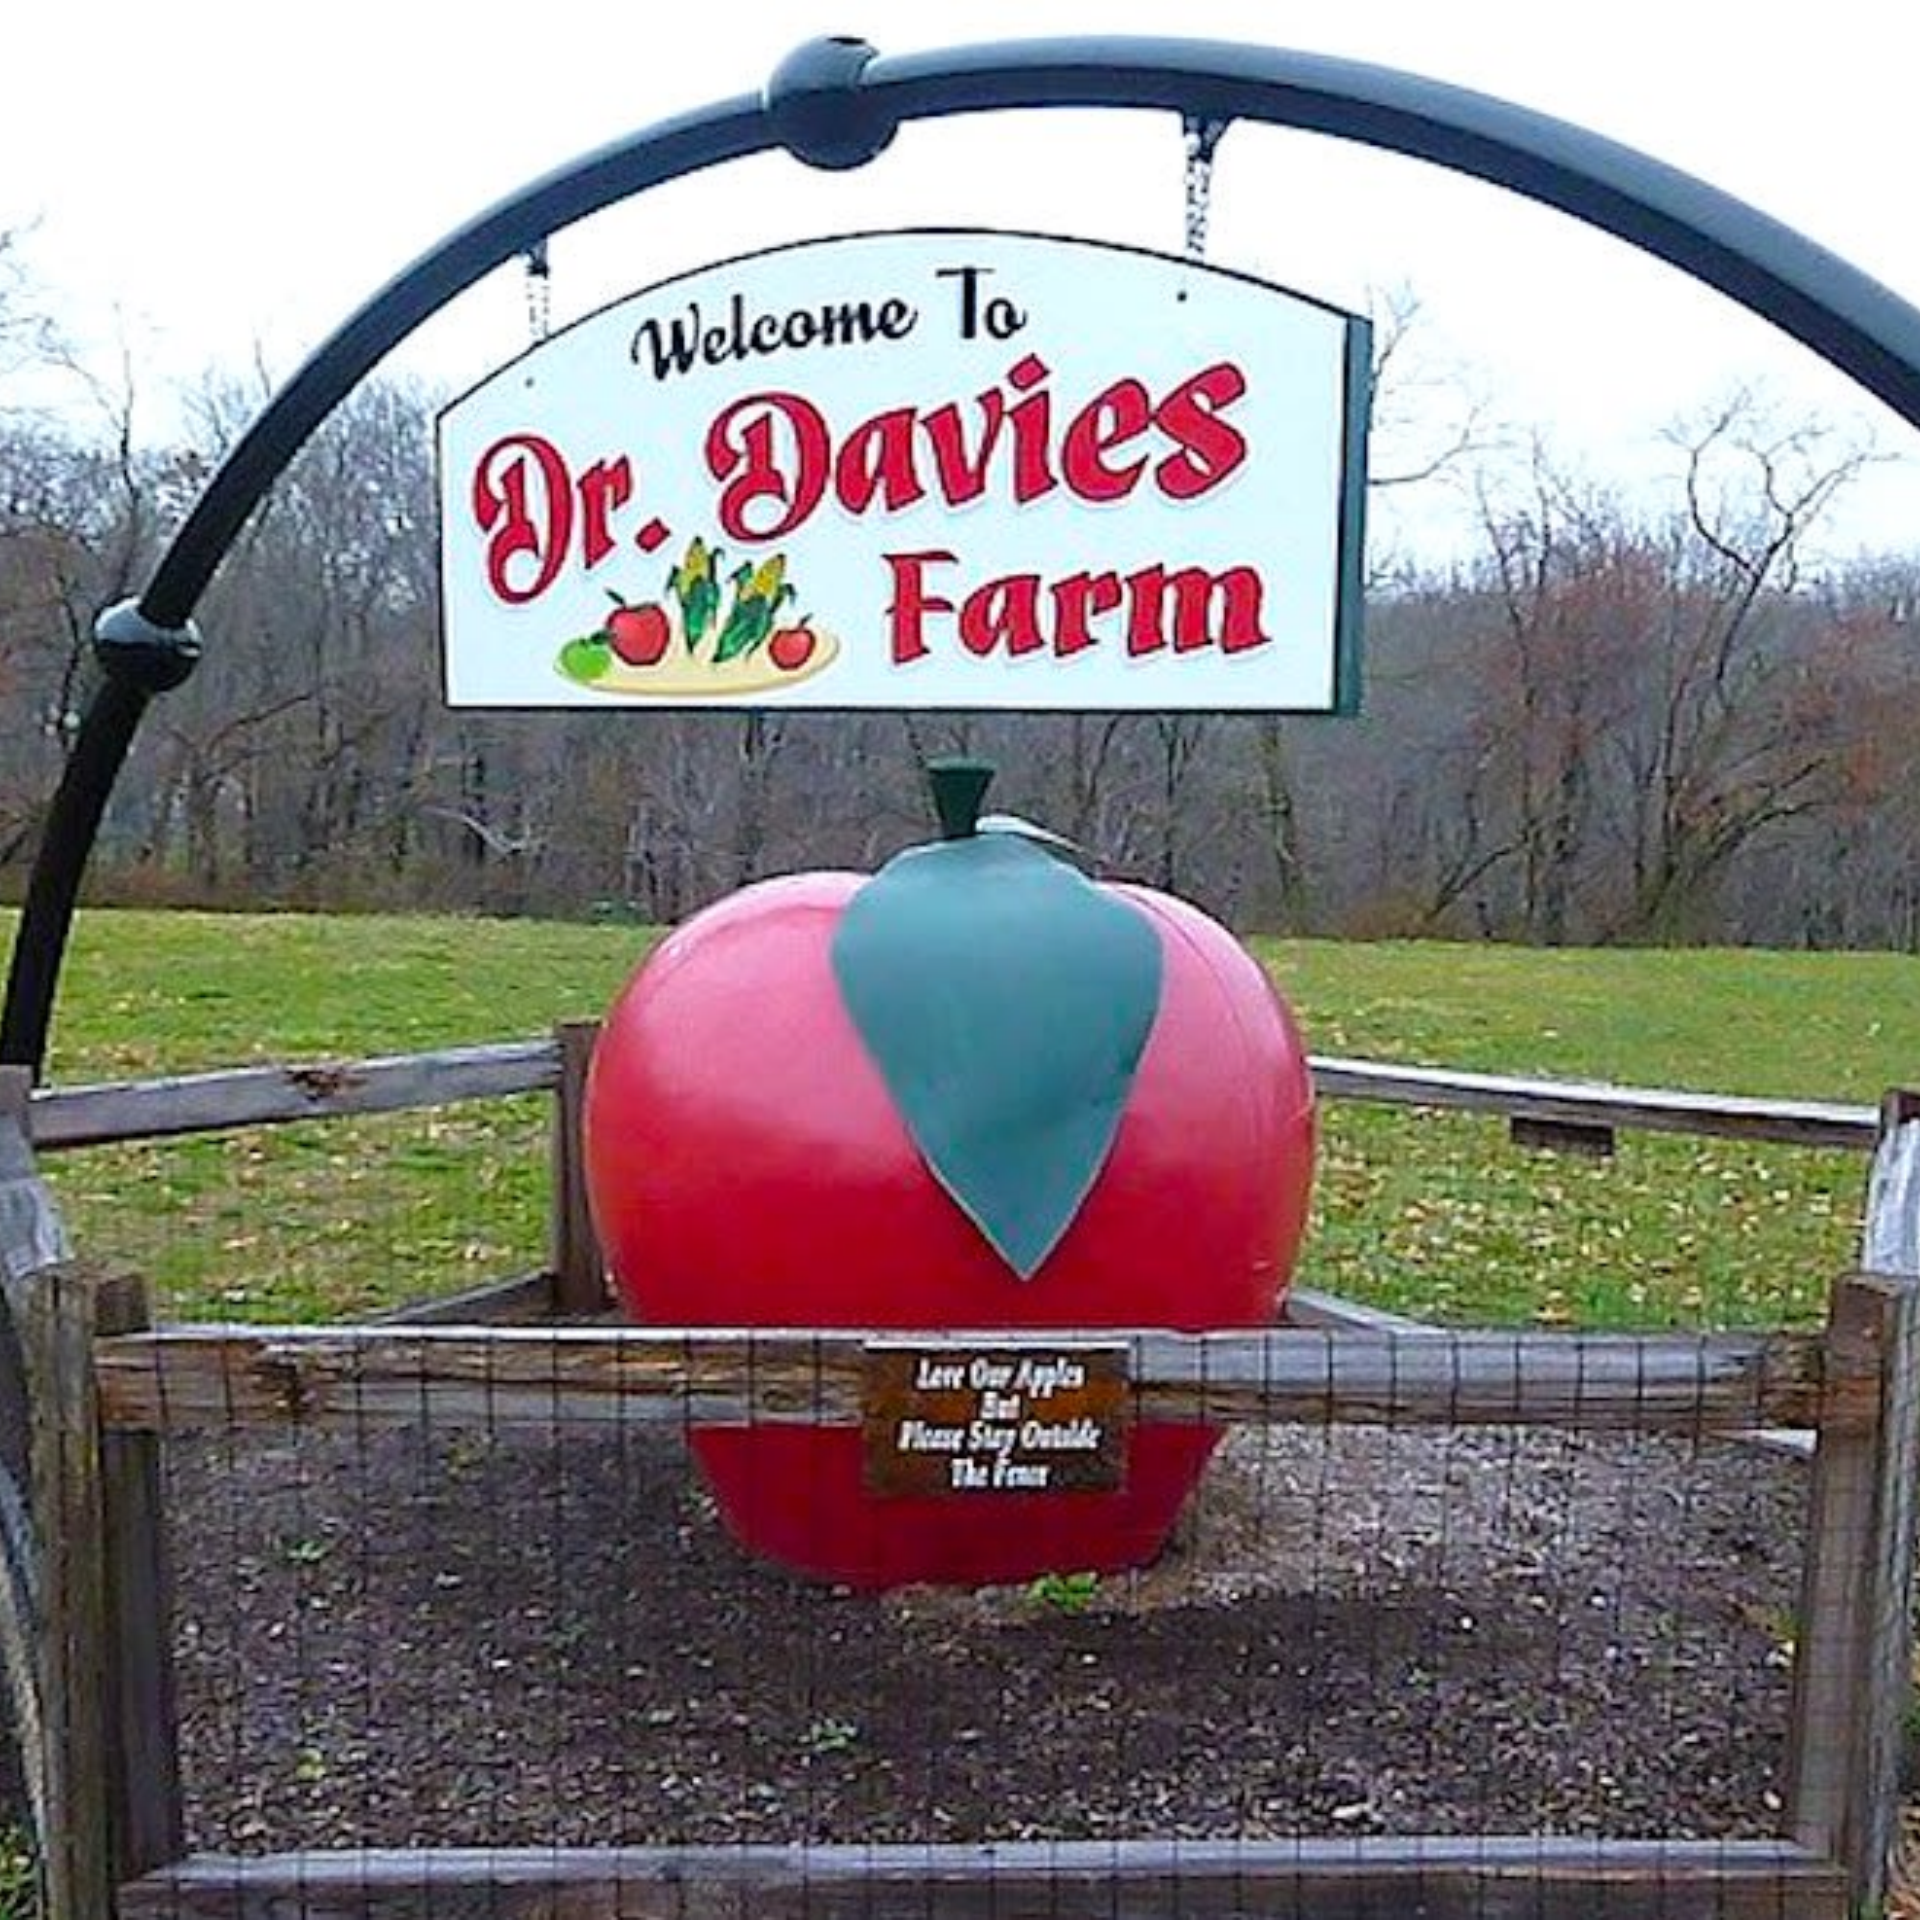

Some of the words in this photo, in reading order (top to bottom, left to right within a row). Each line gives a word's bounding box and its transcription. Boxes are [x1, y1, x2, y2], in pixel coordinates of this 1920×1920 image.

[629, 296, 918, 379] Welcome
[937, 267, 1026, 340] To
[472, 434, 670, 603] Dr.
[706, 353, 1248, 541] Davies
[882, 551, 1271, 664] Farm
[917, 1359, 965, 1390] Love
[970, 1357, 1013, 1390] Our
[1013, 1357, 1085, 1398] Apples
[980, 1391, 1021, 1419] But
[898, 1420, 964, 1450] Please
[968, 1420, 1016, 1456] Stay
[1020, 1418, 1101, 1449] Outside
[951, 1456, 989, 1487] The
[993, 1456, 1050, 1487] Fence
